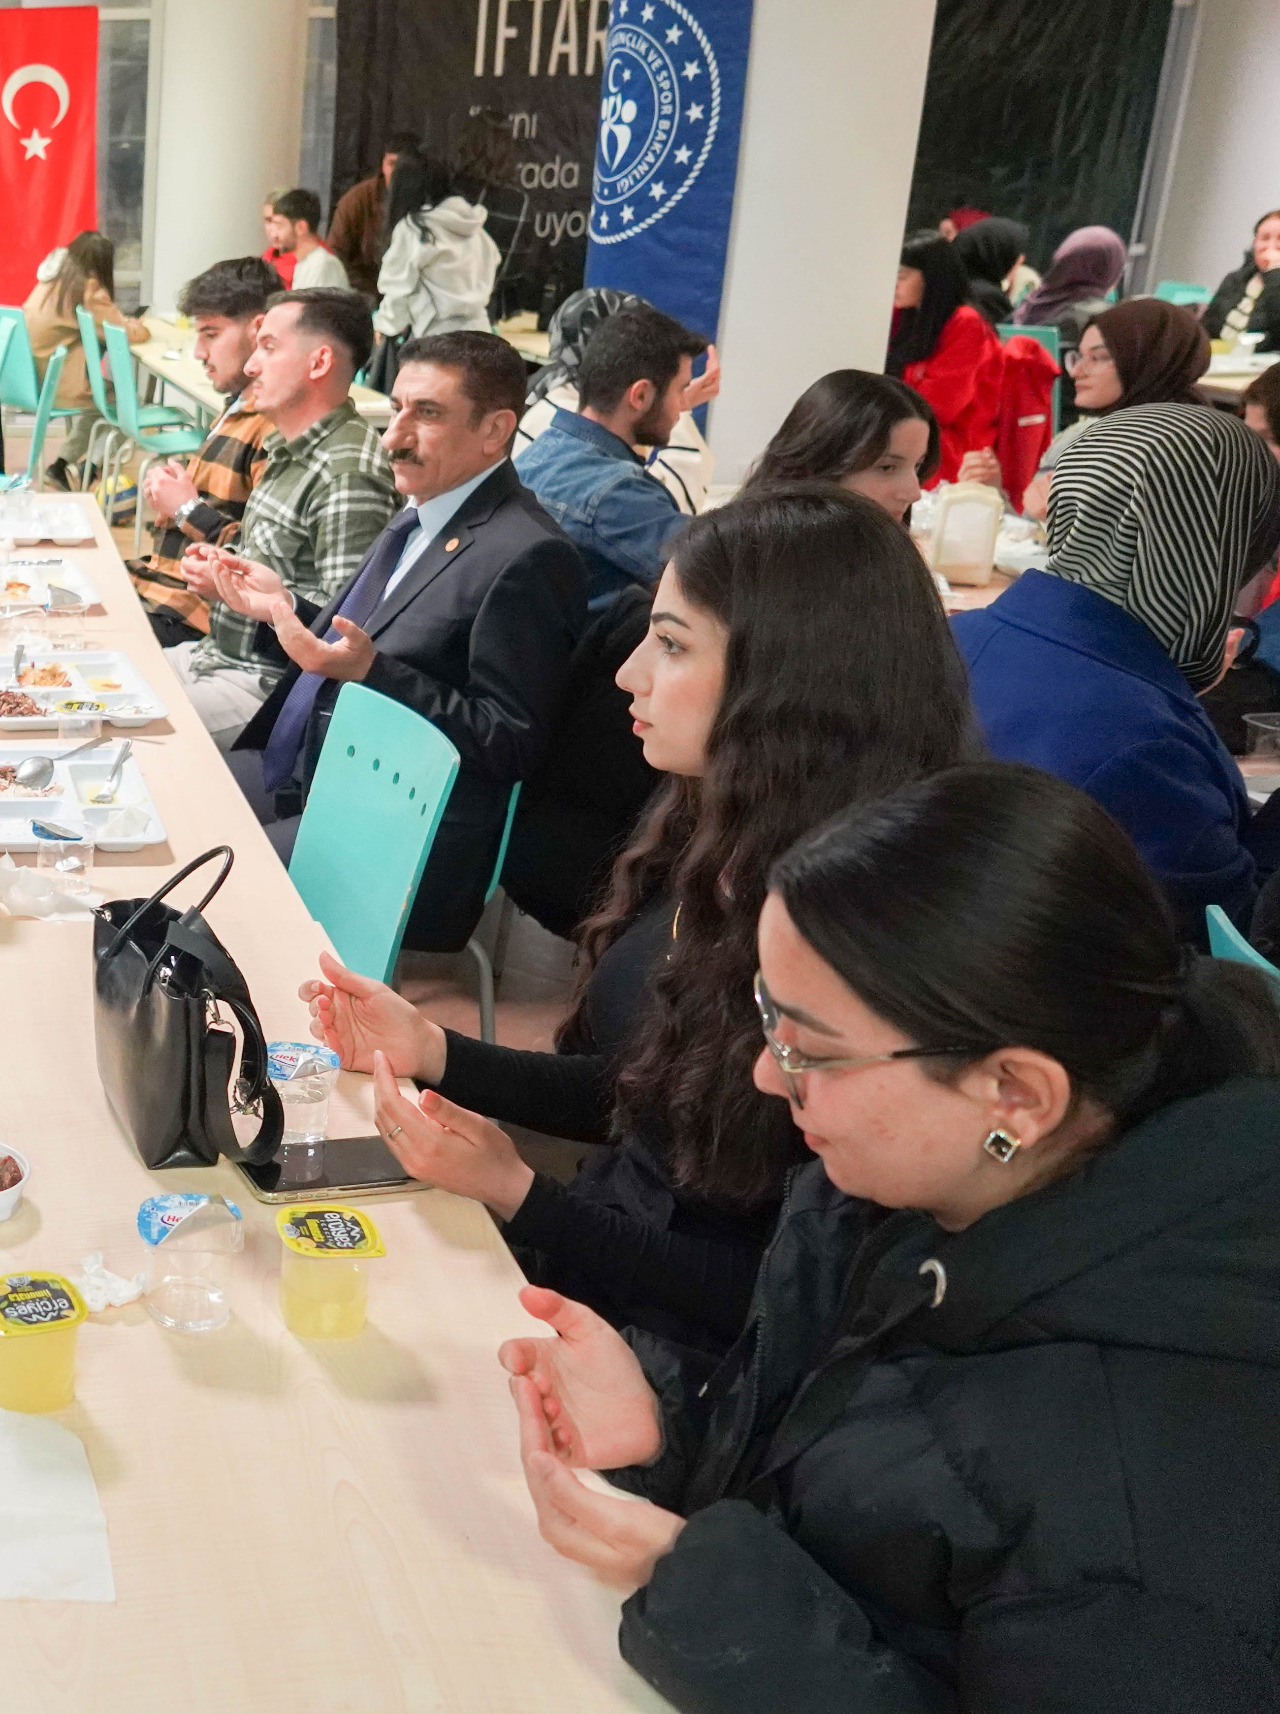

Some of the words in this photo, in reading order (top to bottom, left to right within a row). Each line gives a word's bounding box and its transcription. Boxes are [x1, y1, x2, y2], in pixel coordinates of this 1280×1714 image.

[647, 49, 664, 72] VE
[655, 70, 674, 115] SPOR
[616, 118, 672, 194] BAKANLIĞI
[324, 1212, 355, 1249] erciyes
[4, 1298, 70, 1317] erciyes
